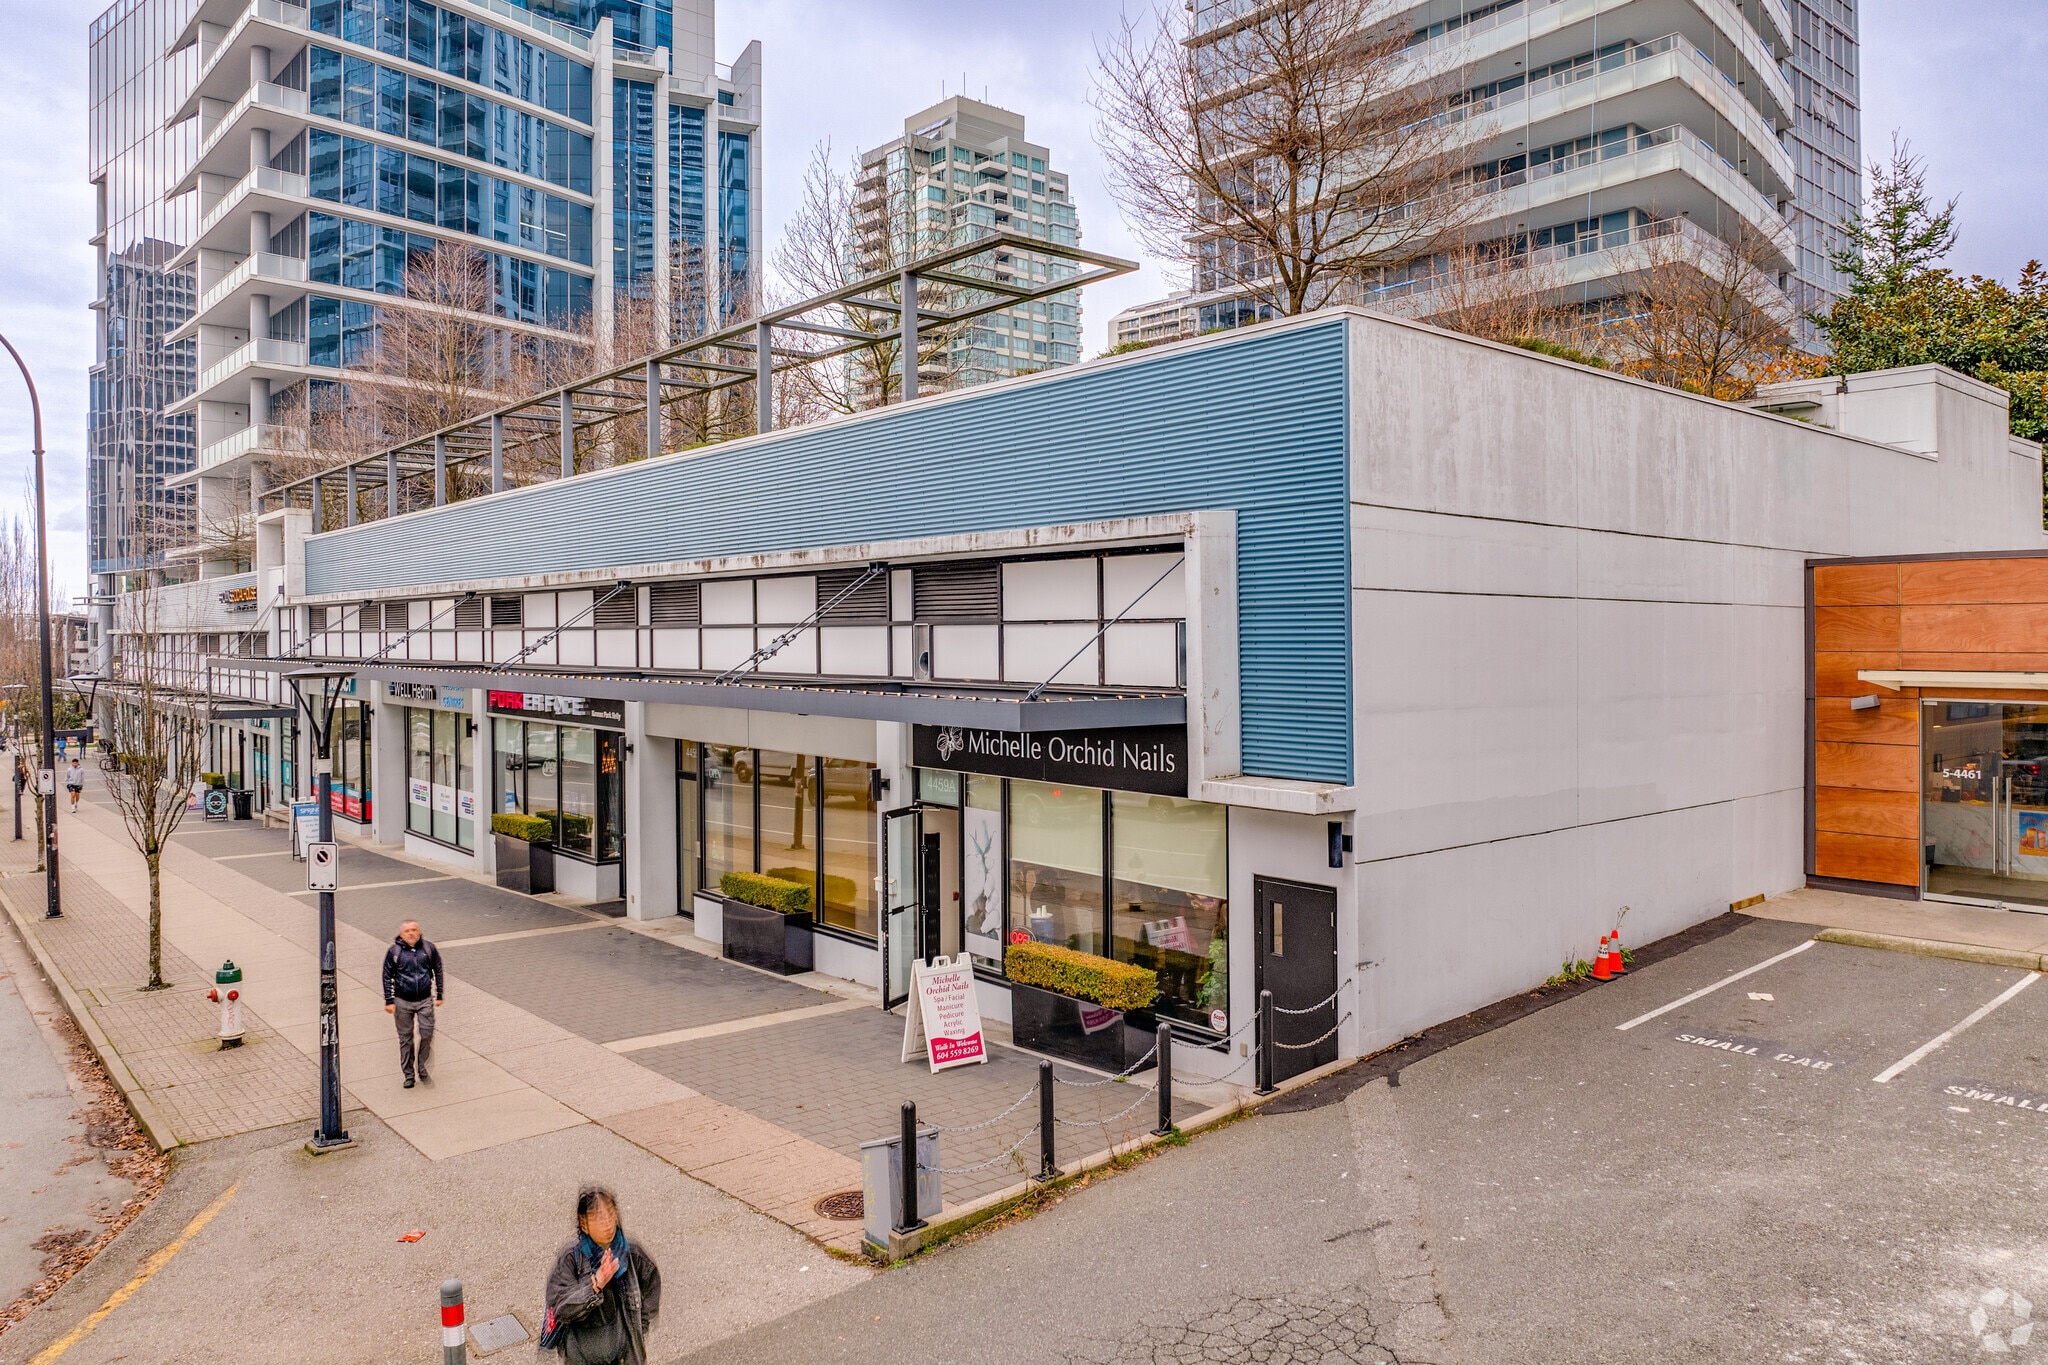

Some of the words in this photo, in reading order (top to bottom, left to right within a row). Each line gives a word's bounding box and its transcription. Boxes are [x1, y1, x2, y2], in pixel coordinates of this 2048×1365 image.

[395, 681, 412, 698] WELL
[968, 731, 1042, 760] Michelle
[1049, 737, 1115, 767] Orchid
[1123, 743, 1176, 773] Nails
[1942, 768, 1982, 780] 5-4461
[927, 777, 956, 792] 4459A
[932, 973, 960, 985] Michelle
[926, 984, 950, 995] Orchid
[952, 981, 969, 991] Nails
[933, 995, 945, 1003] Spa
[948, 993, 965, 1001] Facial
[937, 1003, 964, 1011] Manicure
[939, 1011, 964, 1020] Pedicure
[943, 1020, 963, 1028] Acrylic
[943, 1028, 966, 1036] Waxing
[1675, 1034, 1759, 1056] SMALL
[936, 1051, 949, 1060] 604
[950, 1048, 962, 1057] 559
[962, 1045, 979, 1055] 8269
